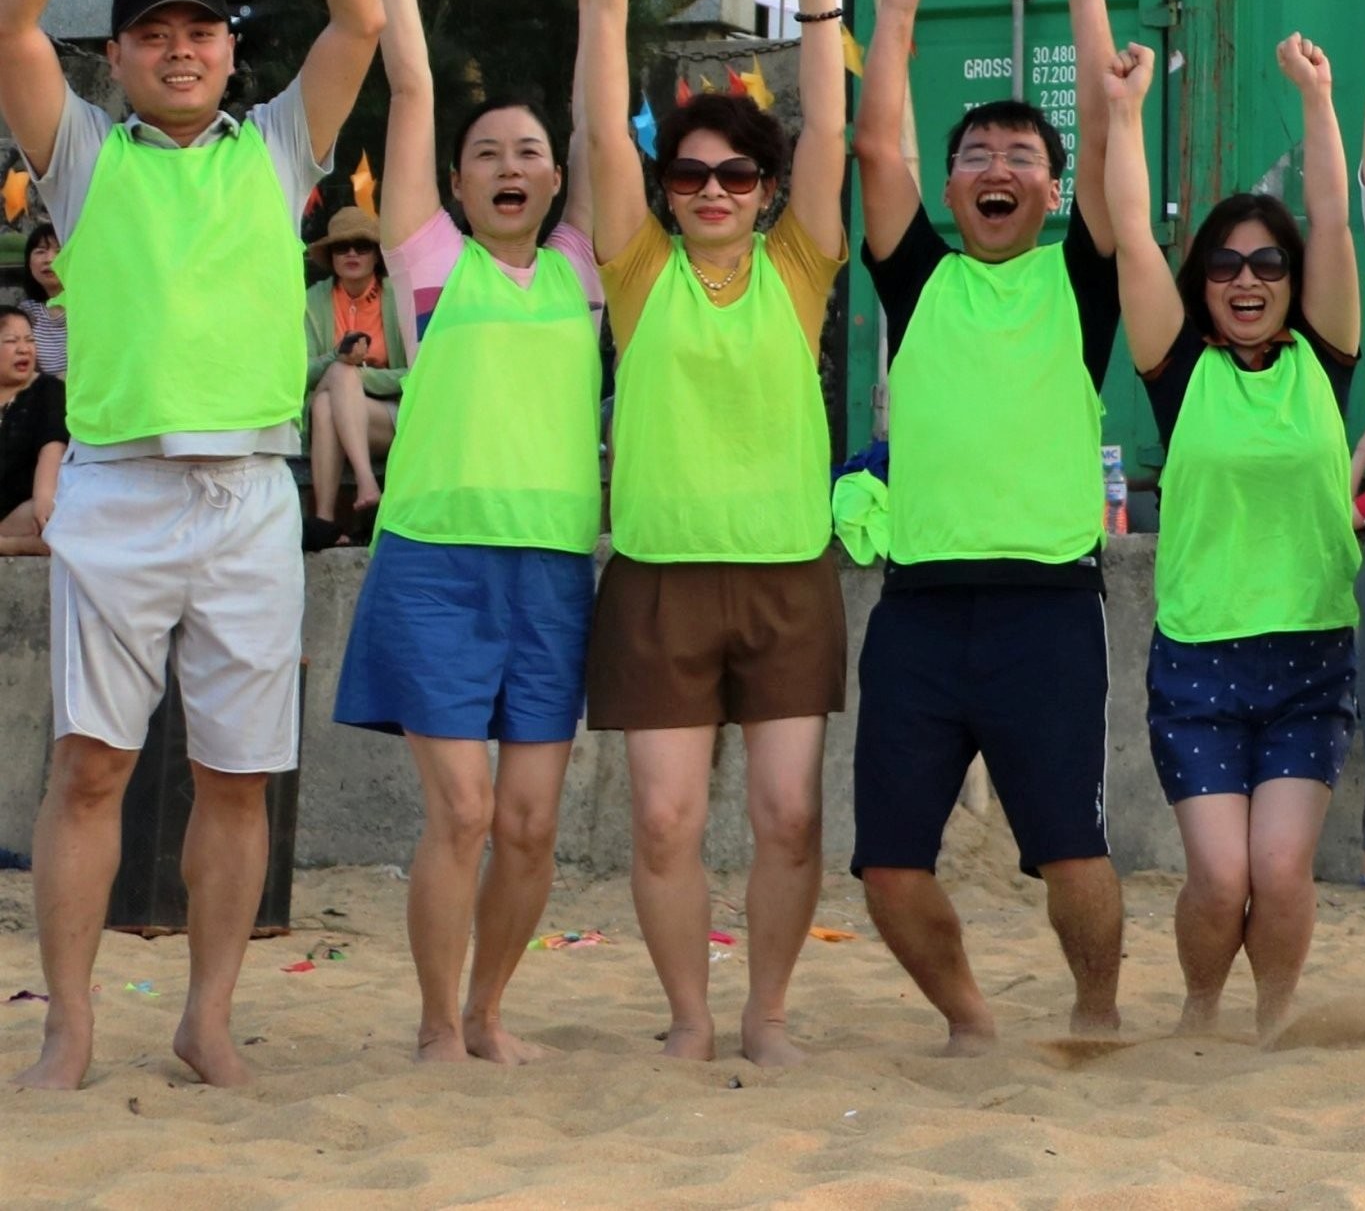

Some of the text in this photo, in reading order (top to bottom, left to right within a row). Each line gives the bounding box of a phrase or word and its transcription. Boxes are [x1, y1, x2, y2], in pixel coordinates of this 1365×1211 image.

[1033, 44, 1077, 64] 30.480
[964, 58, 1013, 79] GROSS
[1032, 65, 1077, 85] 67.200
[1040, 89, 1076, 108] 2.200
